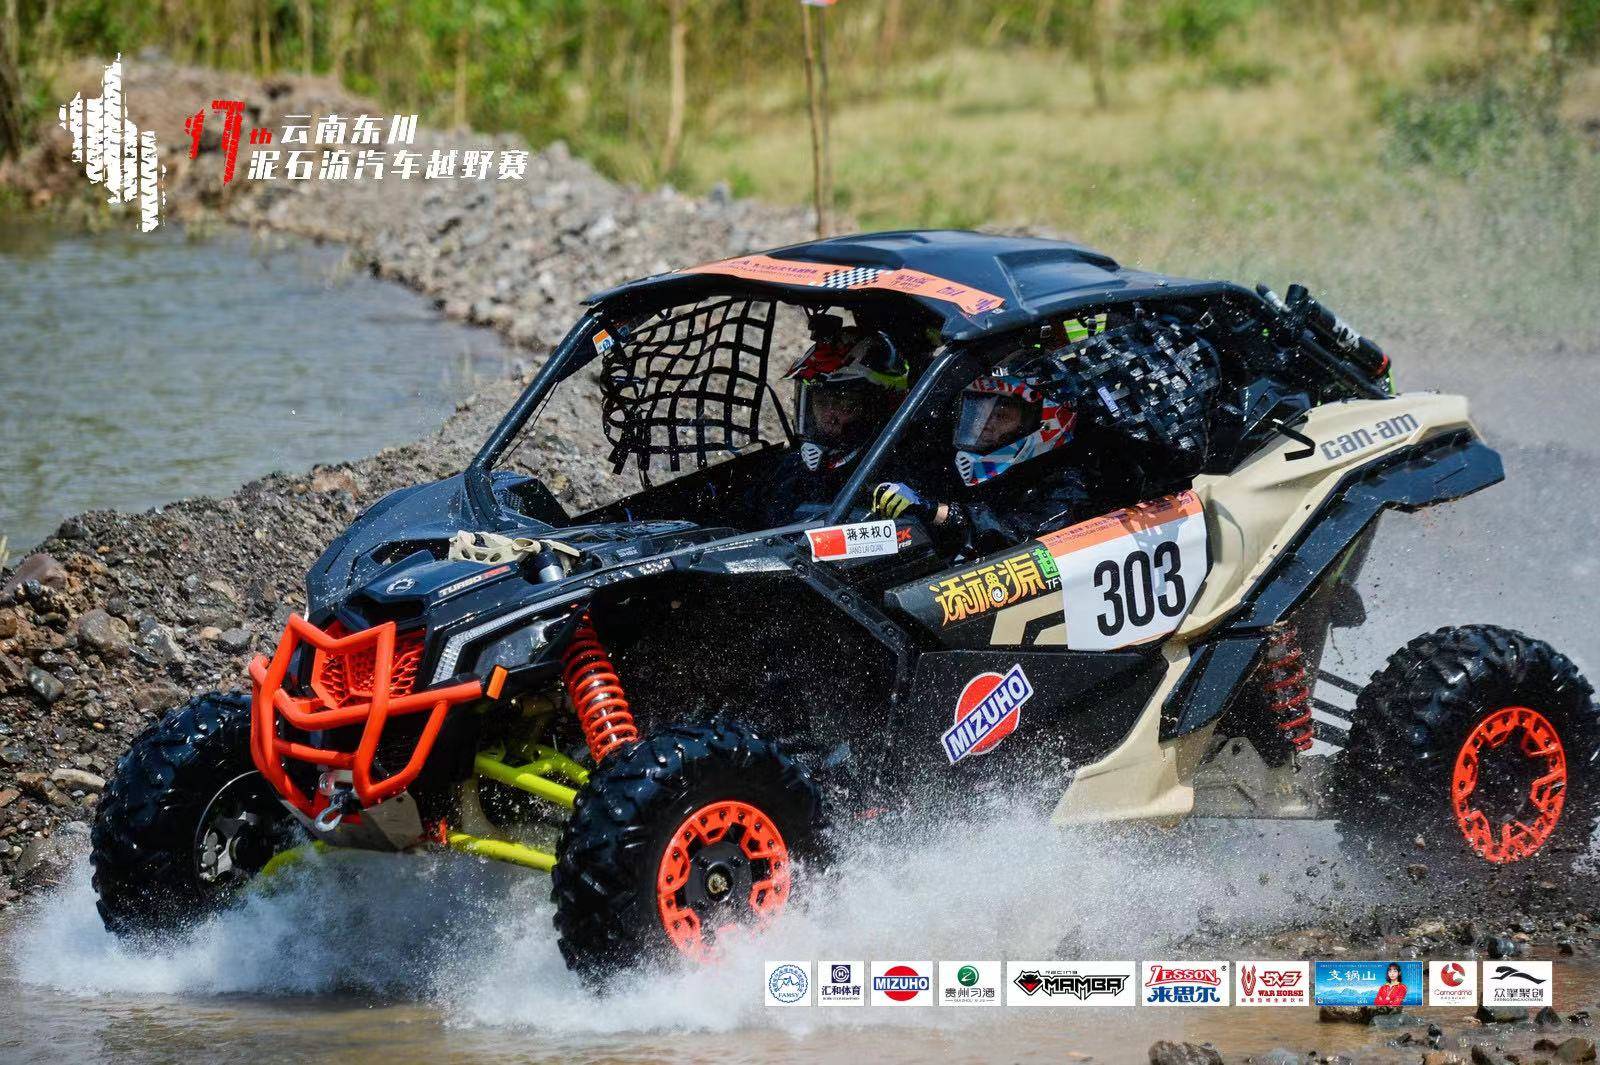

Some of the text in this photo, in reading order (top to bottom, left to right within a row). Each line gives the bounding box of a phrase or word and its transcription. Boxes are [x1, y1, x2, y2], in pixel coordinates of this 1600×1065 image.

[1320, 412, 1419, 461] can-am
[438, 576, 482, 597] TURBO
[1093, 541, 1186, 637] 303
[947, 676, 1028, 759] MIZUHO
